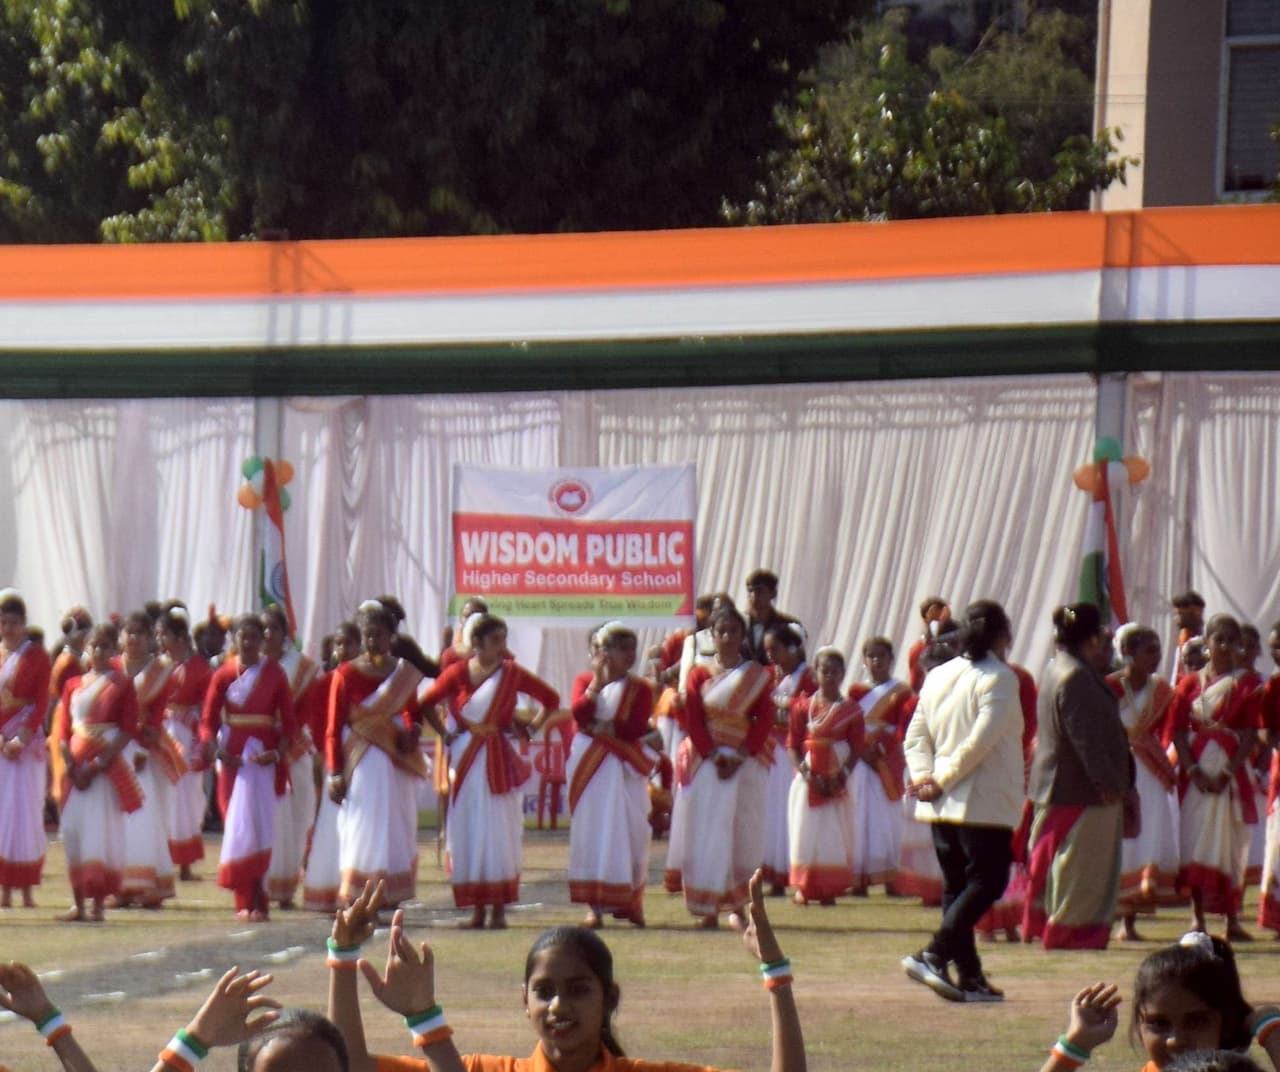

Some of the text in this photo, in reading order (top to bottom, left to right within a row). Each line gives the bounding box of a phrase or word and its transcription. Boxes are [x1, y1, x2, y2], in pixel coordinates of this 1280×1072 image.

[461, 530, 685, 568] WISDOM PUBLIC
[463, 570, 681, 592] Higher Secondary School
[626, 599, 672, 610] Wisdom
